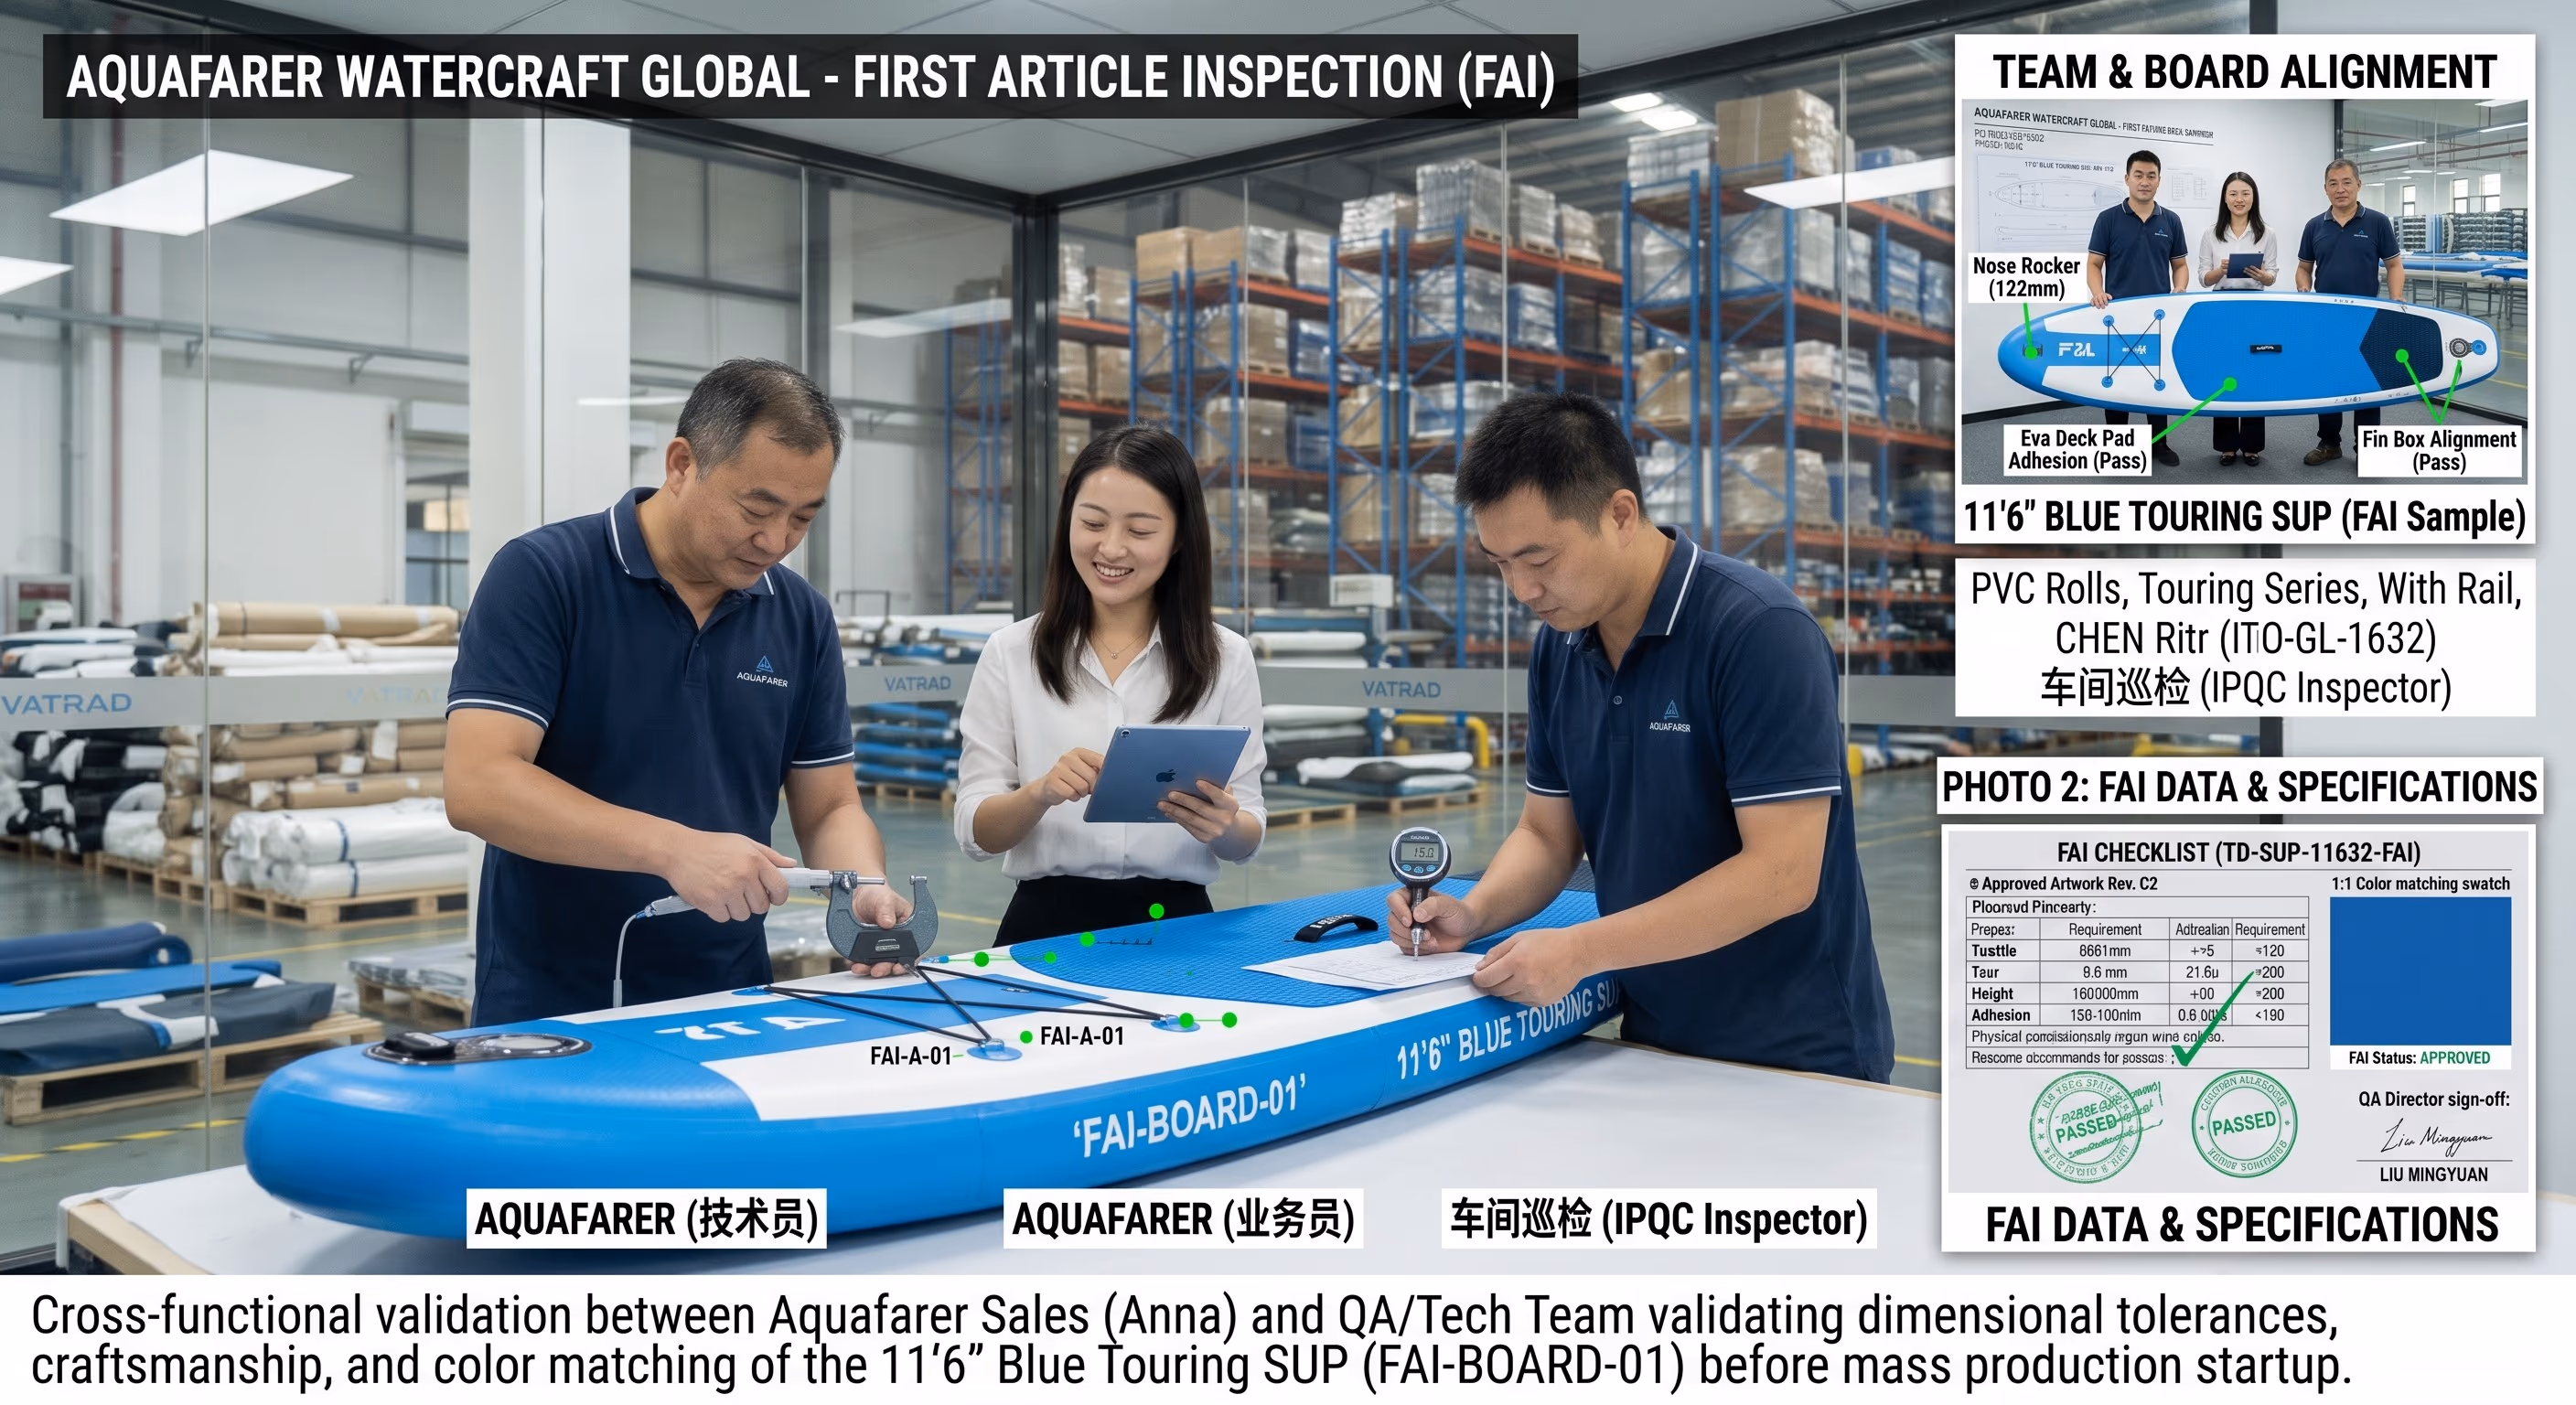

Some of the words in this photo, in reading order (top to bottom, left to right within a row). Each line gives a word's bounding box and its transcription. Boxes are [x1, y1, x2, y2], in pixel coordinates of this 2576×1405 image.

[1974, 107, 2031, 122] AQUAFARER
[2032, 113, 2088, 127] WATERCRAFT
[2089, 118, 2117, 130] GLOBAL
[2122, 123, 2141, 133] FIRST
[885, 675, 951, 692] VATRAD
[1361, 680, 1442, 698] VATRAD
[1, 692, 133, 715] VATRAD
[2057, 842, 2088, 863] FAI
[2094, 842, 2210, 863] CHECKLIST
[2216, 840, 2420, 868] (TD-SUP-11632-FAI)
[1981, 875, 2047, 894] Approved
[2050, 875, 2105, 891] Artwork
[2108, 875, 2136, 891] Rev.
[2139, 876, 2158, 891] C2
[2332, 876, 2351, 891] 1:1
[2356, 875, 2392, 891] Color
[2396, 875, 2458, 894] matching
[2462, 875, 2510, 891] swatch
[2069, 922, 2142, 938] Requirement
[2235, 922, 2306, 938] Requirement
[1971, 943, 2017, 958] Tusttle
[2079, 944, 2131, 957] 8661mm
[2105, 969, 2128, 979] mm
[1971, 986, 2013, 1003] Height
[2073, 987, 2139, 1000] 160000mm
[1971, 1008, 2031, 1022] Adhesion
[1457, 1015, 1512, 1062] BLUE
[1516, 988, 1594, 1042] TOURING
[1971, 1029, 2023, 1046] Physical
[2349, 1050, 2369, 1065] FAI
[2372, 1050, 2417, 1065] Status:
[2420, 1050, 2491, 1065] APPROVED
[2358, 1090, 2382, 1108] QA
[2385, 1090, 2445, 1107] Director
[2448, 1090, 2510, 1111] sign-off:
[2055, 1113, 2118, 1143] PASSED
[2212, 1110, 2277, 1136] PASSED
[2380, 1166, 2404, 1182] LIU
[2408, 1166, 2488, 1182] MINGYUAN
